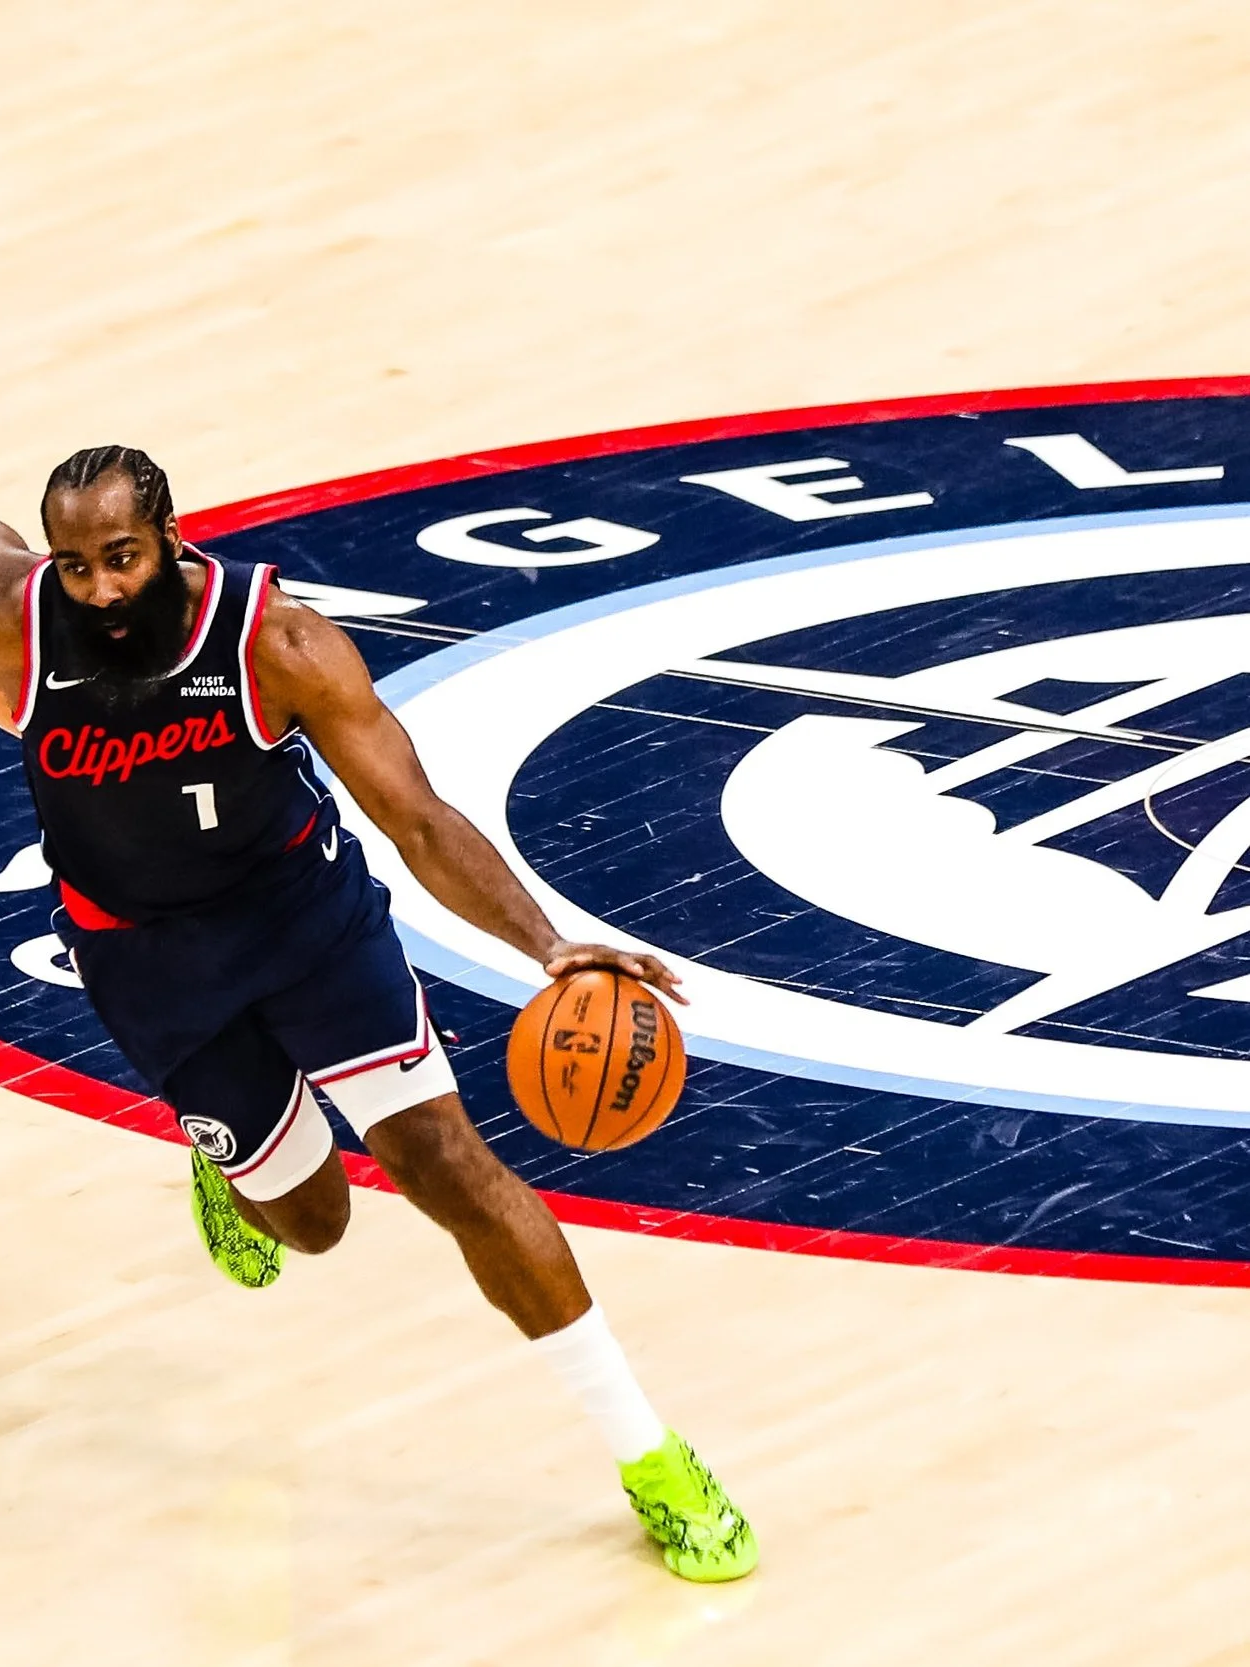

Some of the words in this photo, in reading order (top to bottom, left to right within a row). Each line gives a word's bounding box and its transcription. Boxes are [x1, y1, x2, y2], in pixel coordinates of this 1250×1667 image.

[180, 686, 237, 697] RWANDA
[191, 675, 225, 687] VISIT
[39, 710, 236, 787] Clippers
[181, 783, 219, 831] 1
[609, 1000, 658, 1113] Wilson
